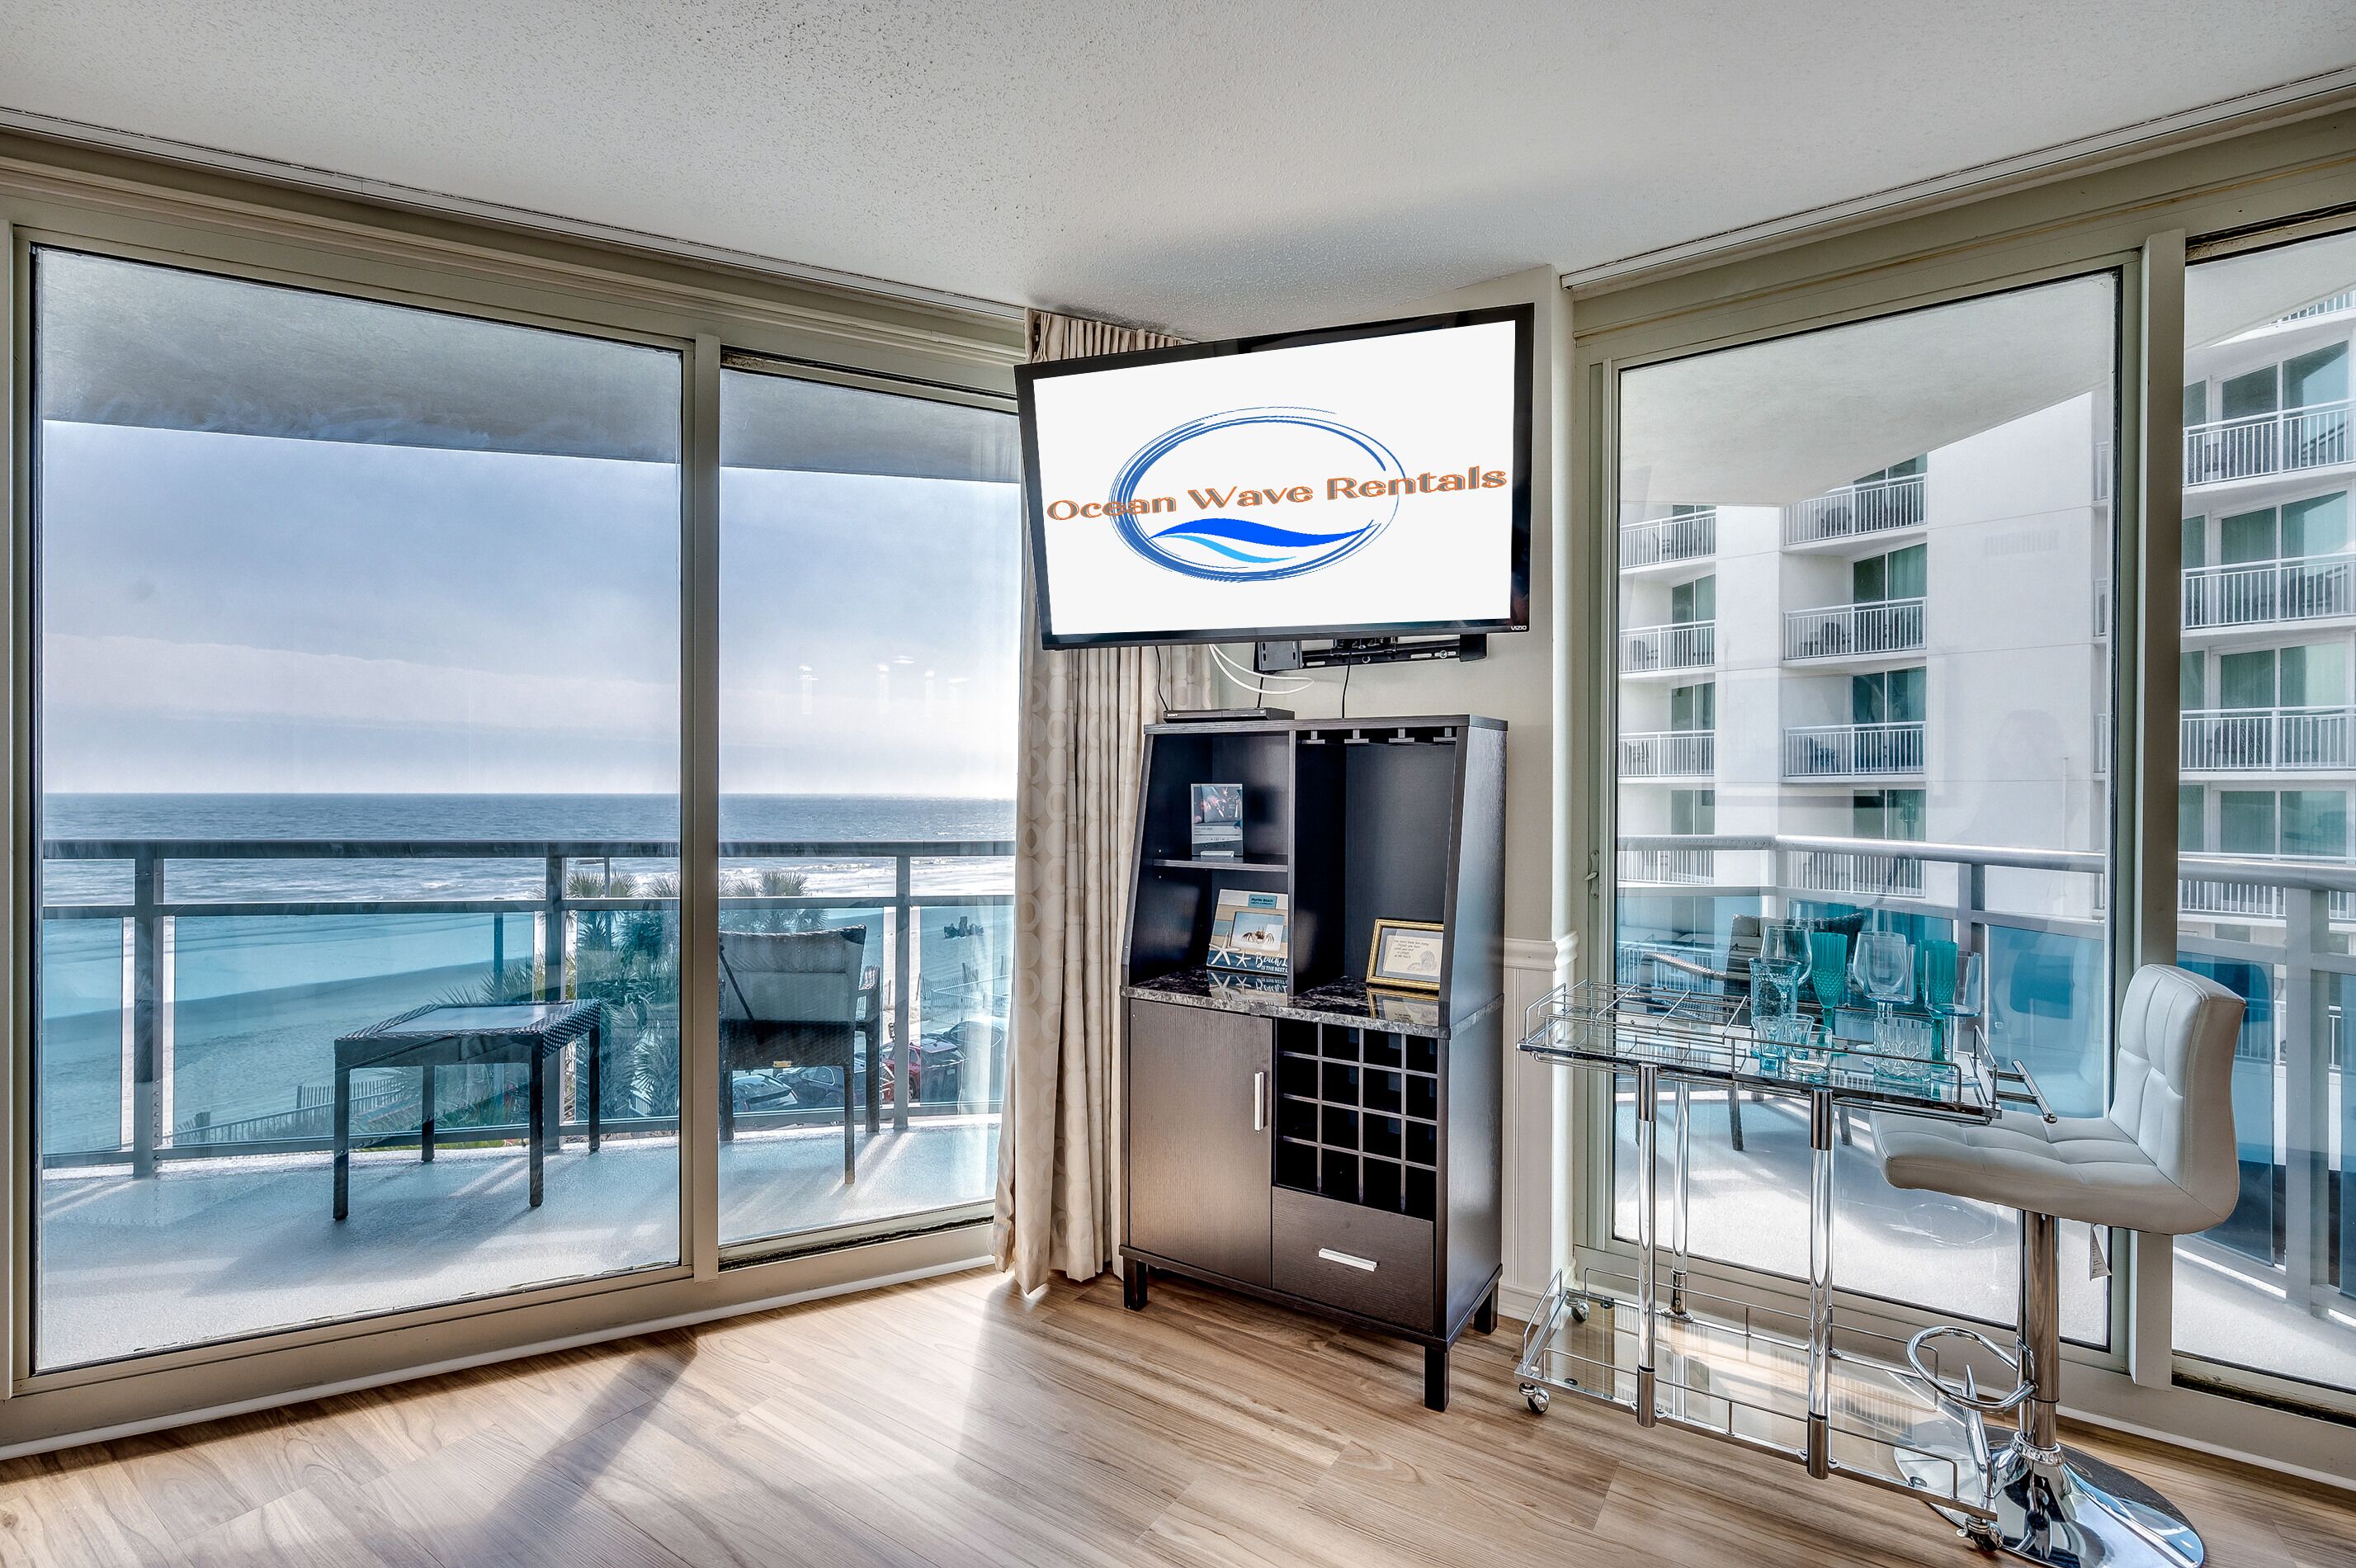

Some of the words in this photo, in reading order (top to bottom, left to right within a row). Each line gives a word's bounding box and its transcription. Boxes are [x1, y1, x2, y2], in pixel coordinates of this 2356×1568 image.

[1046, 496, 1178, 520] Ocean
[1187, 485, 1313, 508] Wave
[1326, 465, 1507, 500] Rentals
[1254, 952, 1282, 968] Beach
